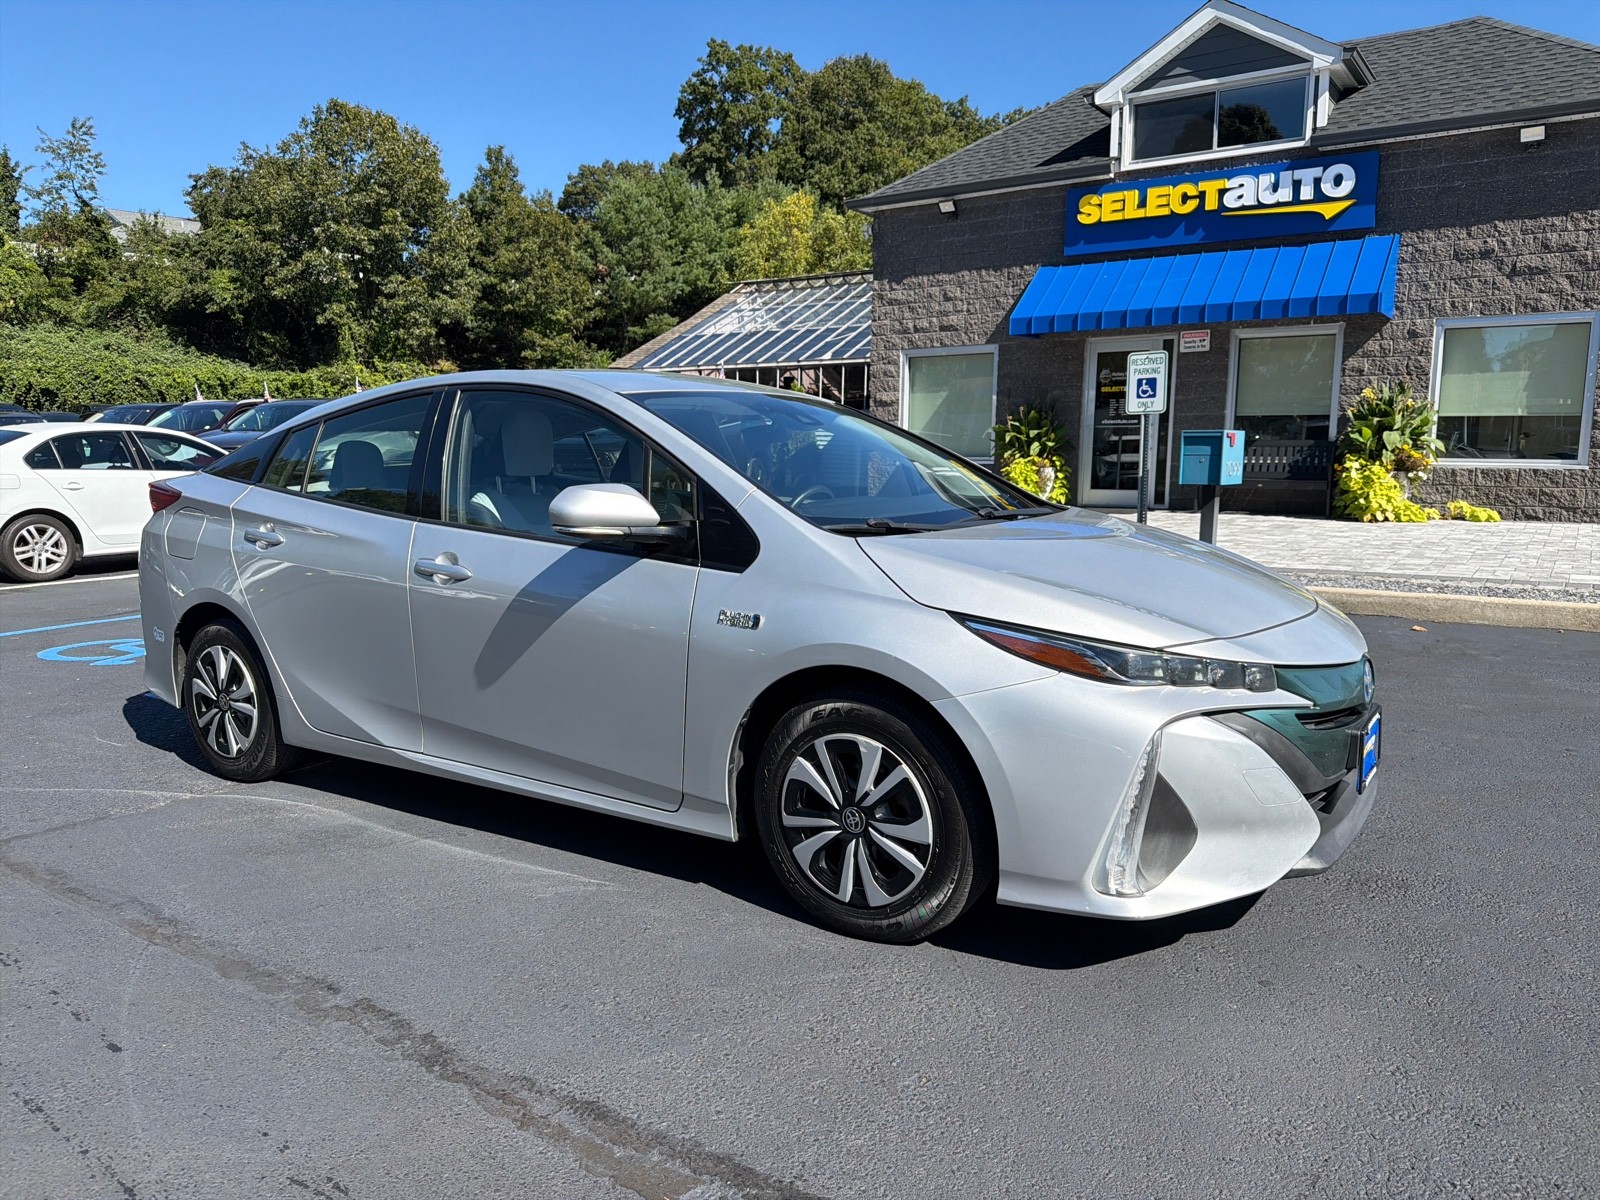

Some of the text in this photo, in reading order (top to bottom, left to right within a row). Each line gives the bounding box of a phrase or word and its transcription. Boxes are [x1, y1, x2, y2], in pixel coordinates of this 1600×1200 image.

[1131, 356, 1164, 366] RESERVED
[1133, 366, 1161, 376] PARKING
[1137, 400, 1155, 409] ONLY
